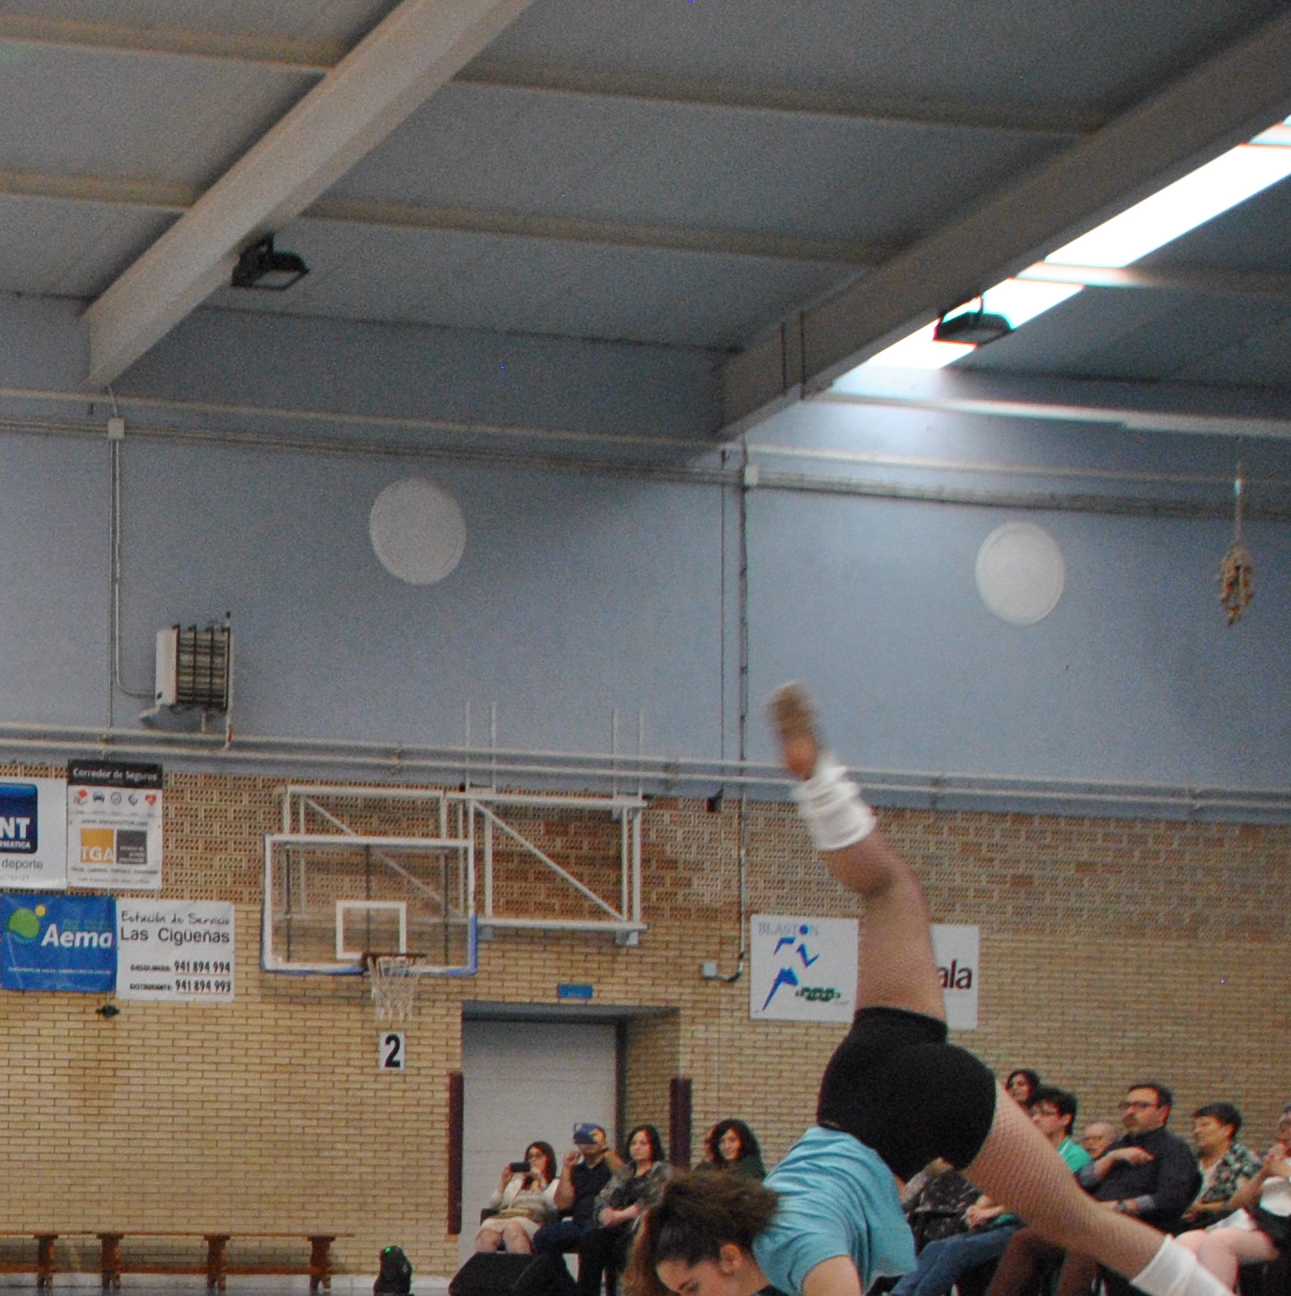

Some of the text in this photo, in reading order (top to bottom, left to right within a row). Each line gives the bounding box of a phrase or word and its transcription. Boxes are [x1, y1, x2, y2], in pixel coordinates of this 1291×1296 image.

[72, 768, 111, 778] Corredor
[113, 769, 123, 779] de
[81, 846, 113, 862] TGA
[2, 858, 44, 872] deporte
[171, 913, 184, 924] de
[40, 923, 113, 949] Aema
[120, 927, 149, 941] Las
[174, 960, 190, 973] 941
[193, 961, 210, 973] 894
[213, 961, 230, 973] 994
[176, 979, 191, 992] 941
[194, 979, 211, 992] 894
[214, 980, 232, 993] 993
[384, 1033, 402, 1068] 2
